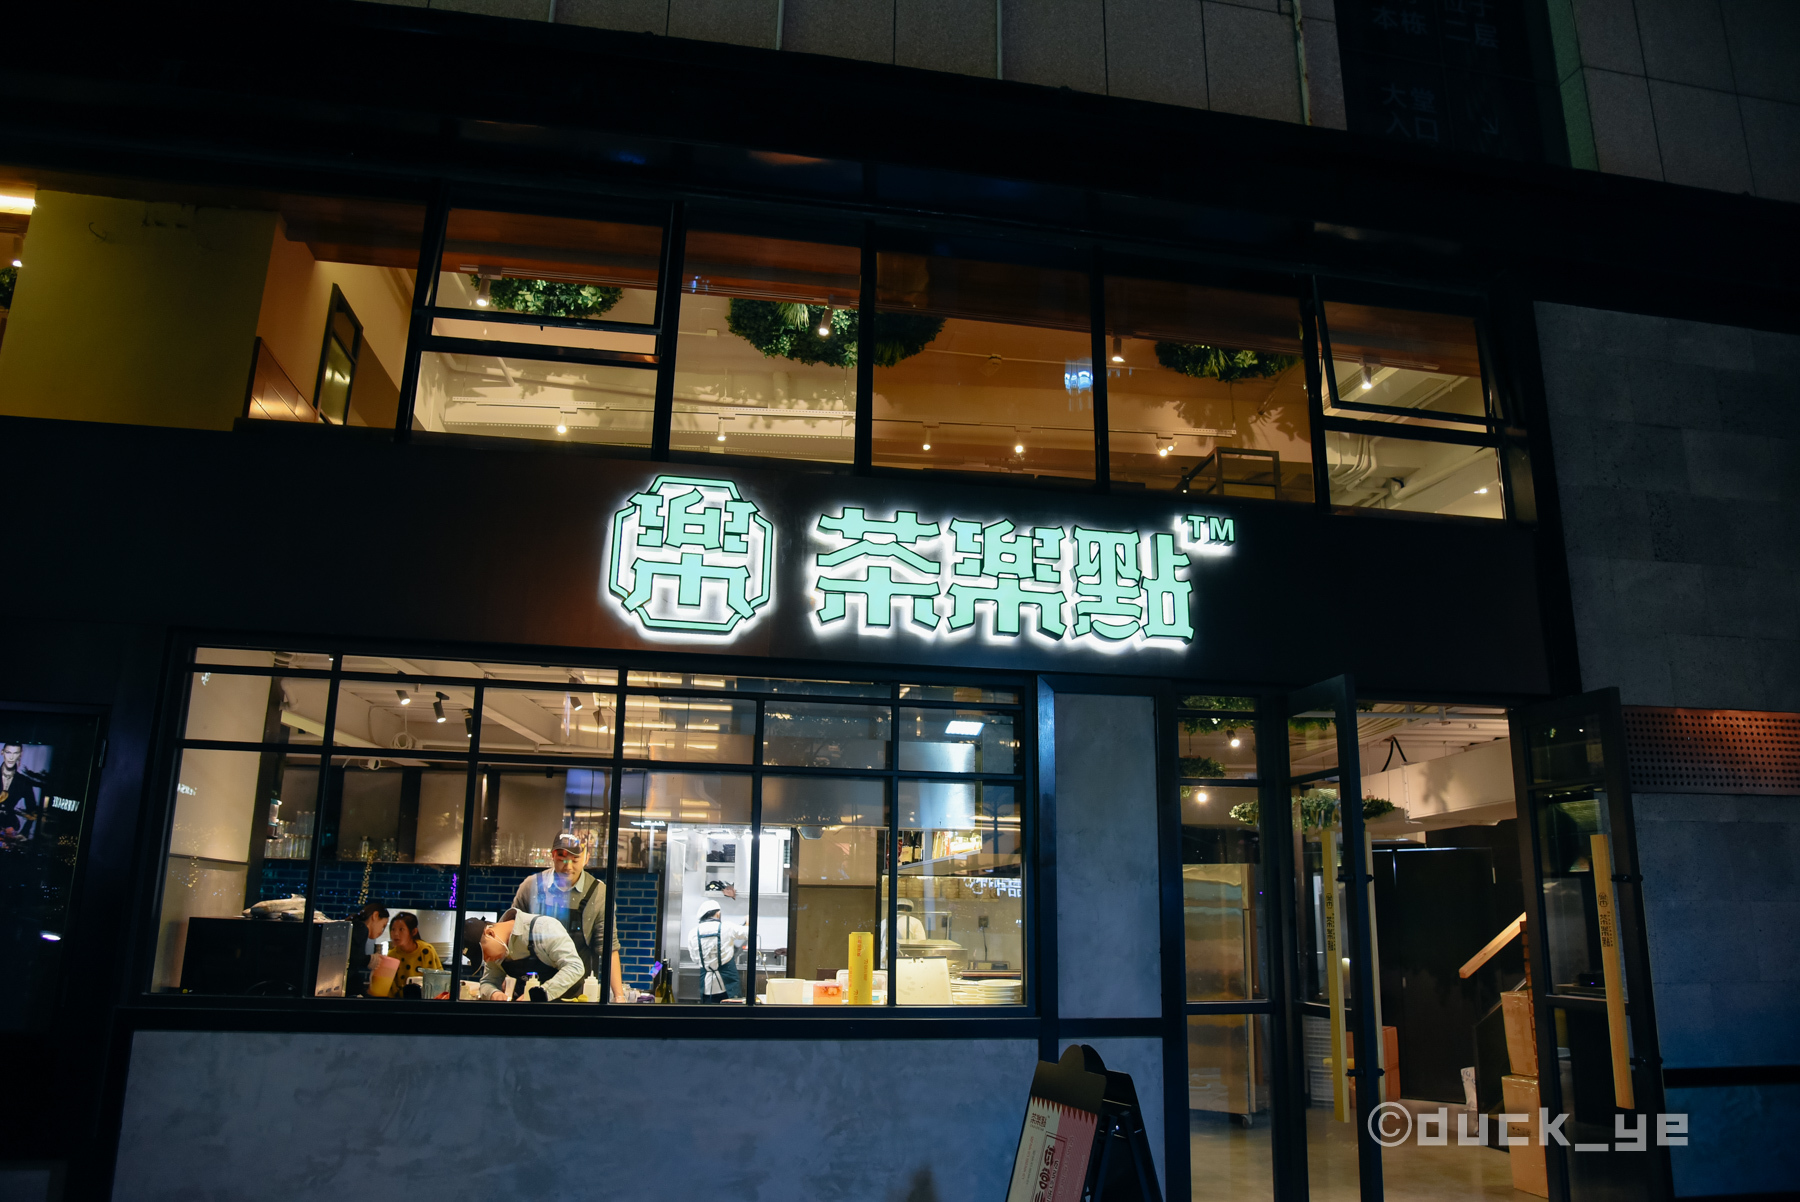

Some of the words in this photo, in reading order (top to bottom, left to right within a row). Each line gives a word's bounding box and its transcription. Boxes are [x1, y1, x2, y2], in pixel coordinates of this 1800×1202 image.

[1371, 5, 1428, 35] 本栋
[1444, 18, 1502, 50] 二层
[1380, 82, 1438, 114] 大堂
[1385, 111, 1440, 143] 入口
